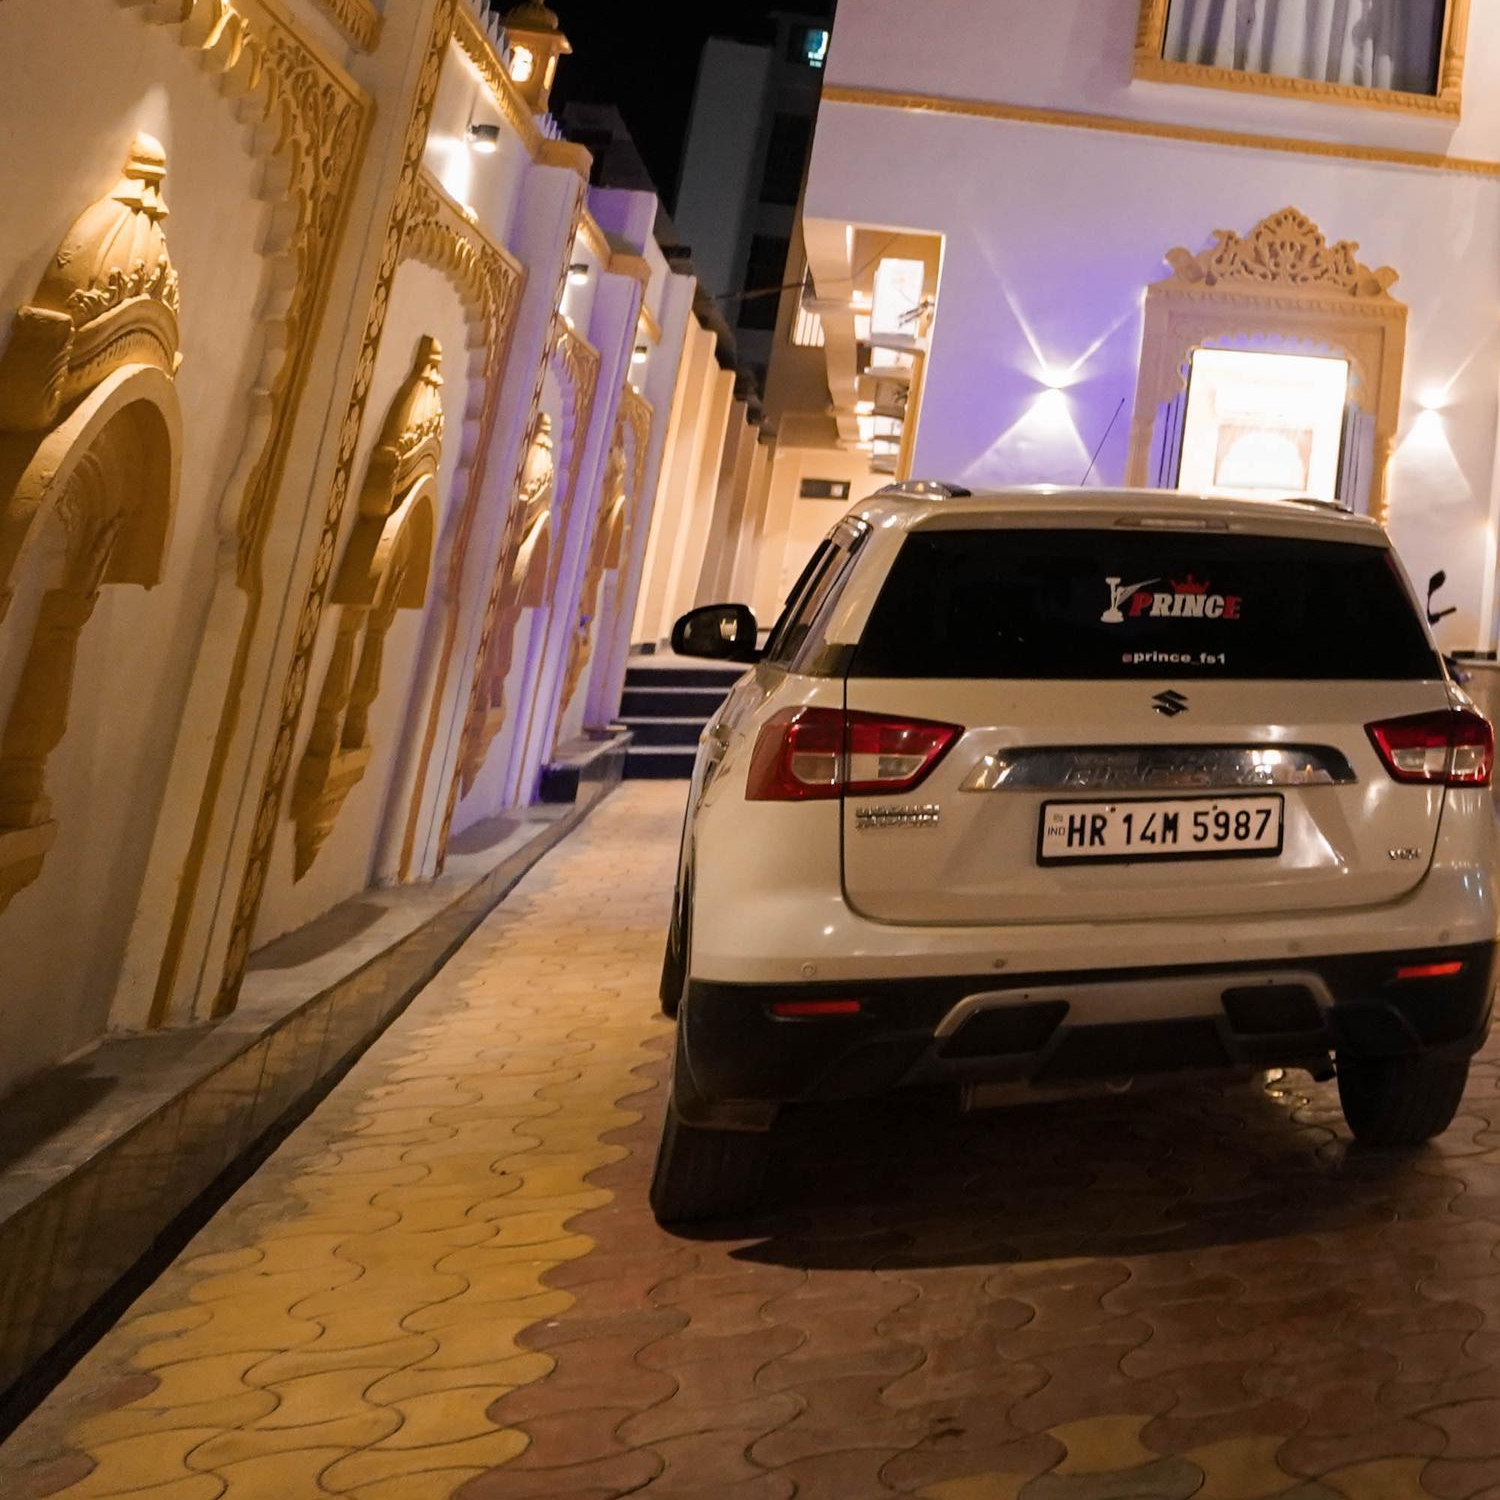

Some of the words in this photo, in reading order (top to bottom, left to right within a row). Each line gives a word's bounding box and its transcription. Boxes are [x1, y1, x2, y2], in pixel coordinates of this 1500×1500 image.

[1129, 592, 1243, 619] PRINCE
[1047, 825, 1067, 837] IND
[1067, 814, 1108, 848] HR
[1122, 811, 1180, 846] 14M
[1193, 808, 1272, 843] 5987
